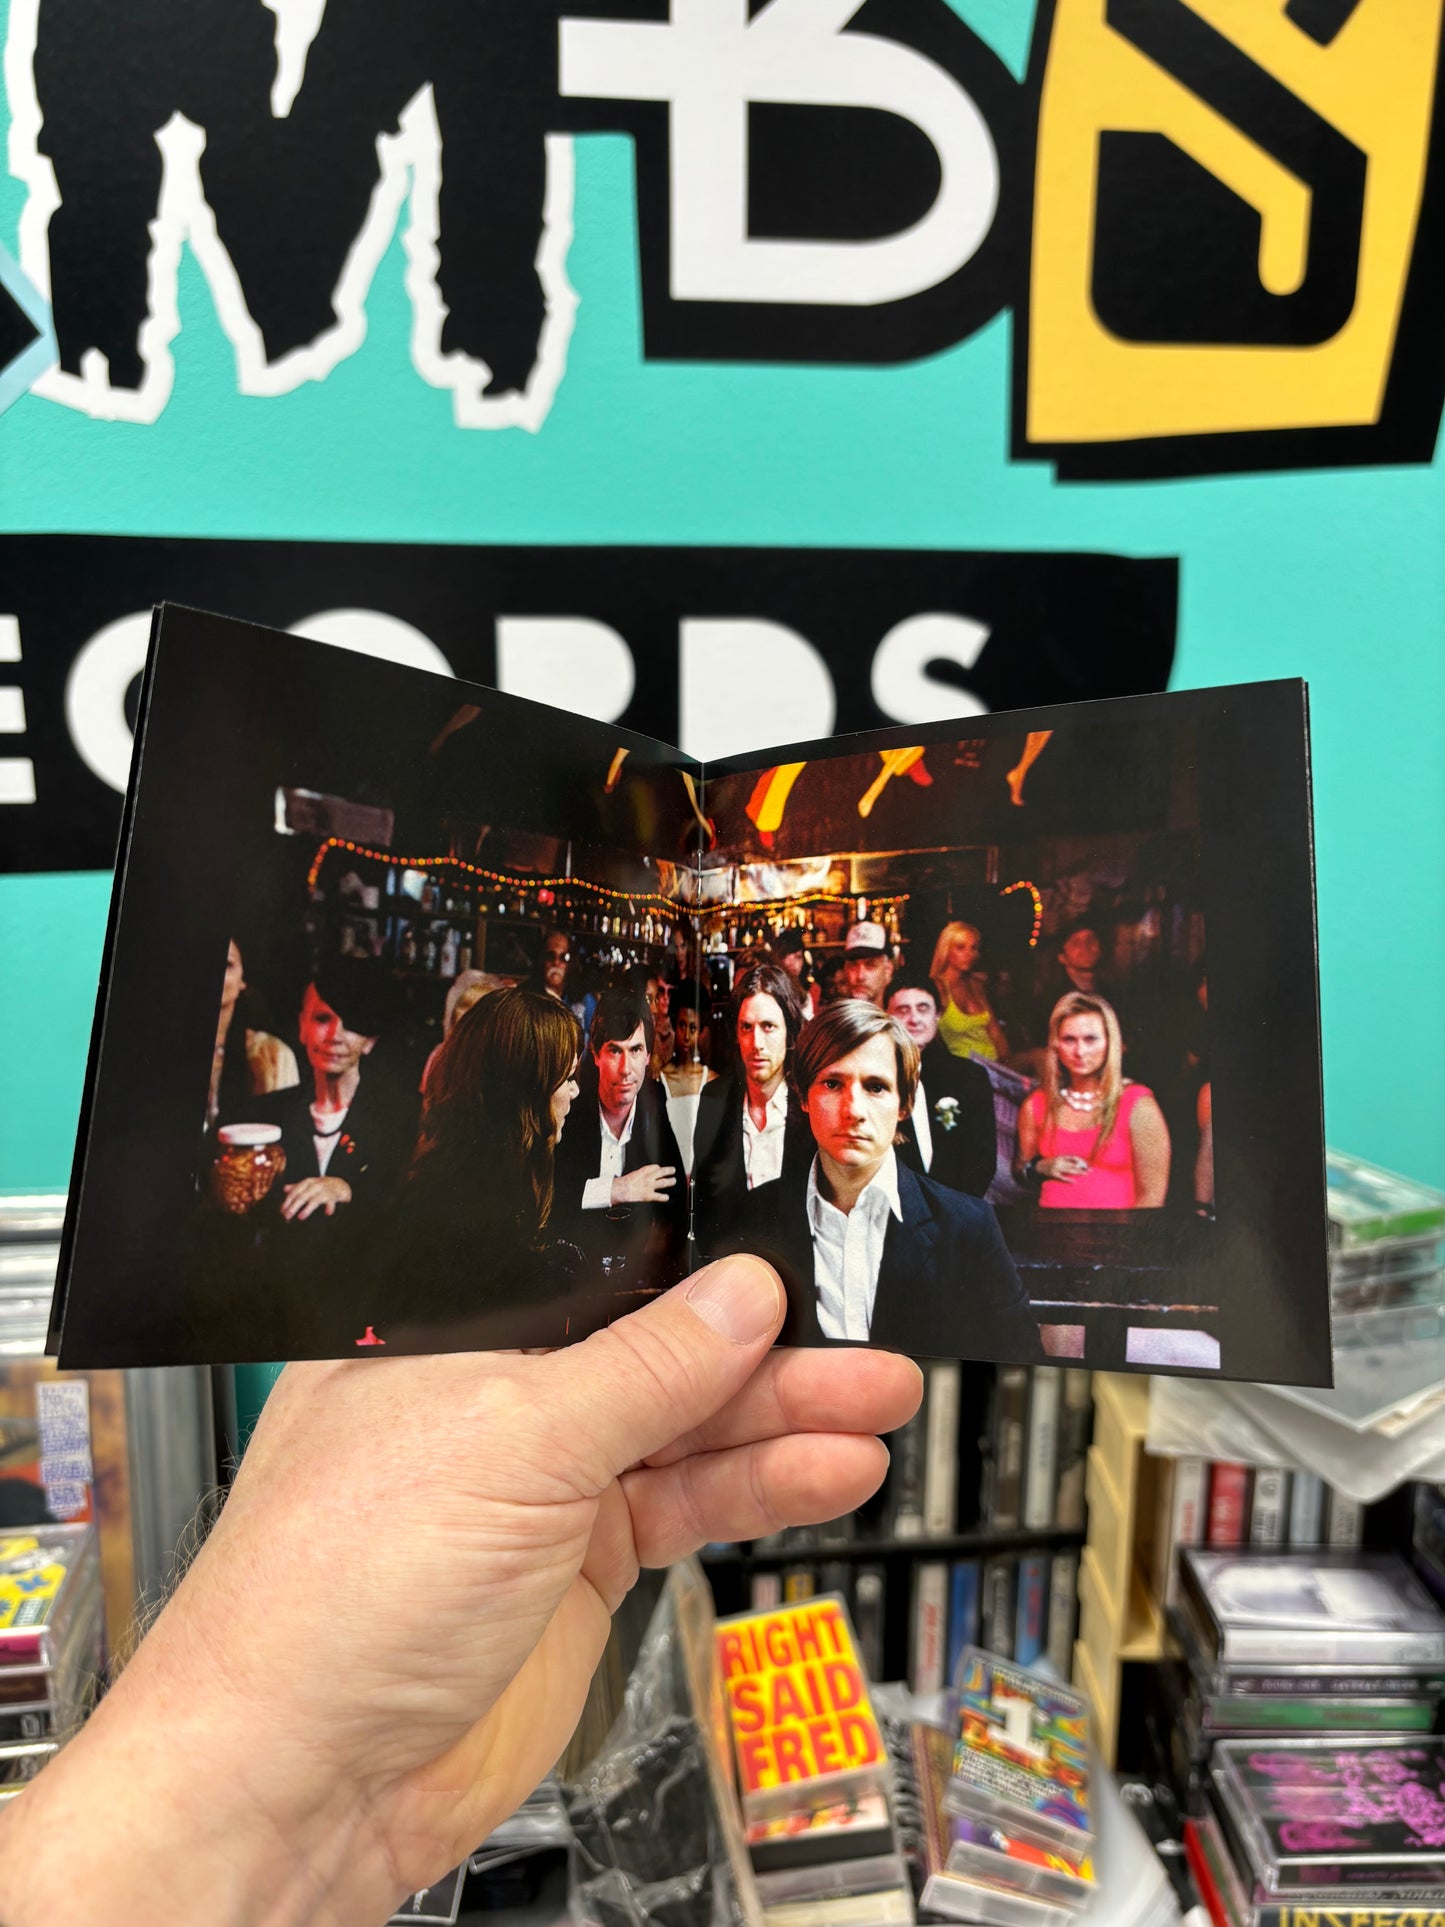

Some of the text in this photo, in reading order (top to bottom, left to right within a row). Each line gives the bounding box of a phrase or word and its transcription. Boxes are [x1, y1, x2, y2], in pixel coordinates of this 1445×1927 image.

[719, 1608, 843, 1678] RIGHT
[732, 1660, 864, 1733] SAID
[741, 1713, 879, 1791] FRED
